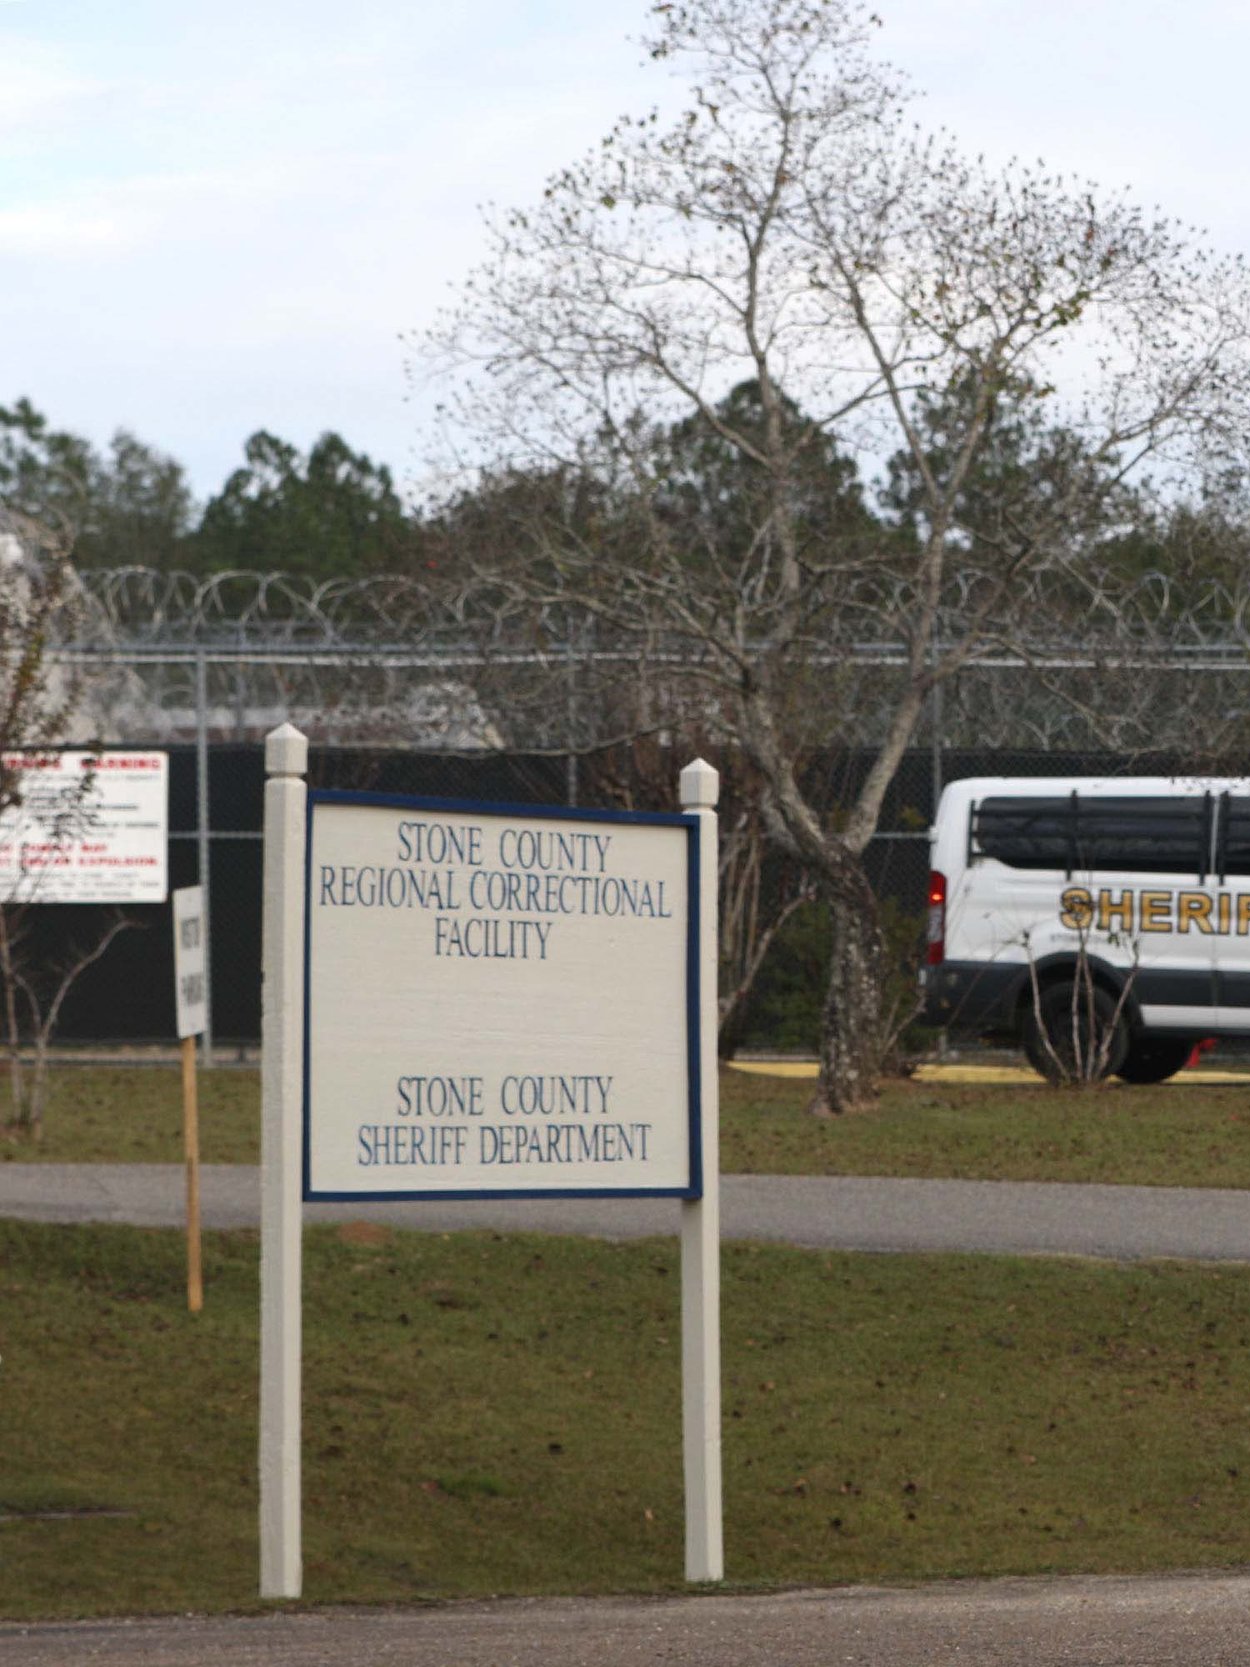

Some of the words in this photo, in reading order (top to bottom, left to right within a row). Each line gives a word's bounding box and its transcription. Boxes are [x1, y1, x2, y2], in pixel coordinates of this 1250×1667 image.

[397, 821, 483, 865] STONE
[499, 828, 612, 873] COUNTY
[319, 865, 460, 911] REGIONAL
[469, 870, 673, 918] CORRECTIONAL
[434, 917, 553, 960] FACILITY
[397, 1076, 484, 1117] STONE
[500, 1075, 614, 1116] COUNTY
[358, 1124, 467, 1166] SHERIFF
[480, 1123, 652, 1164] DEPARTMENT
